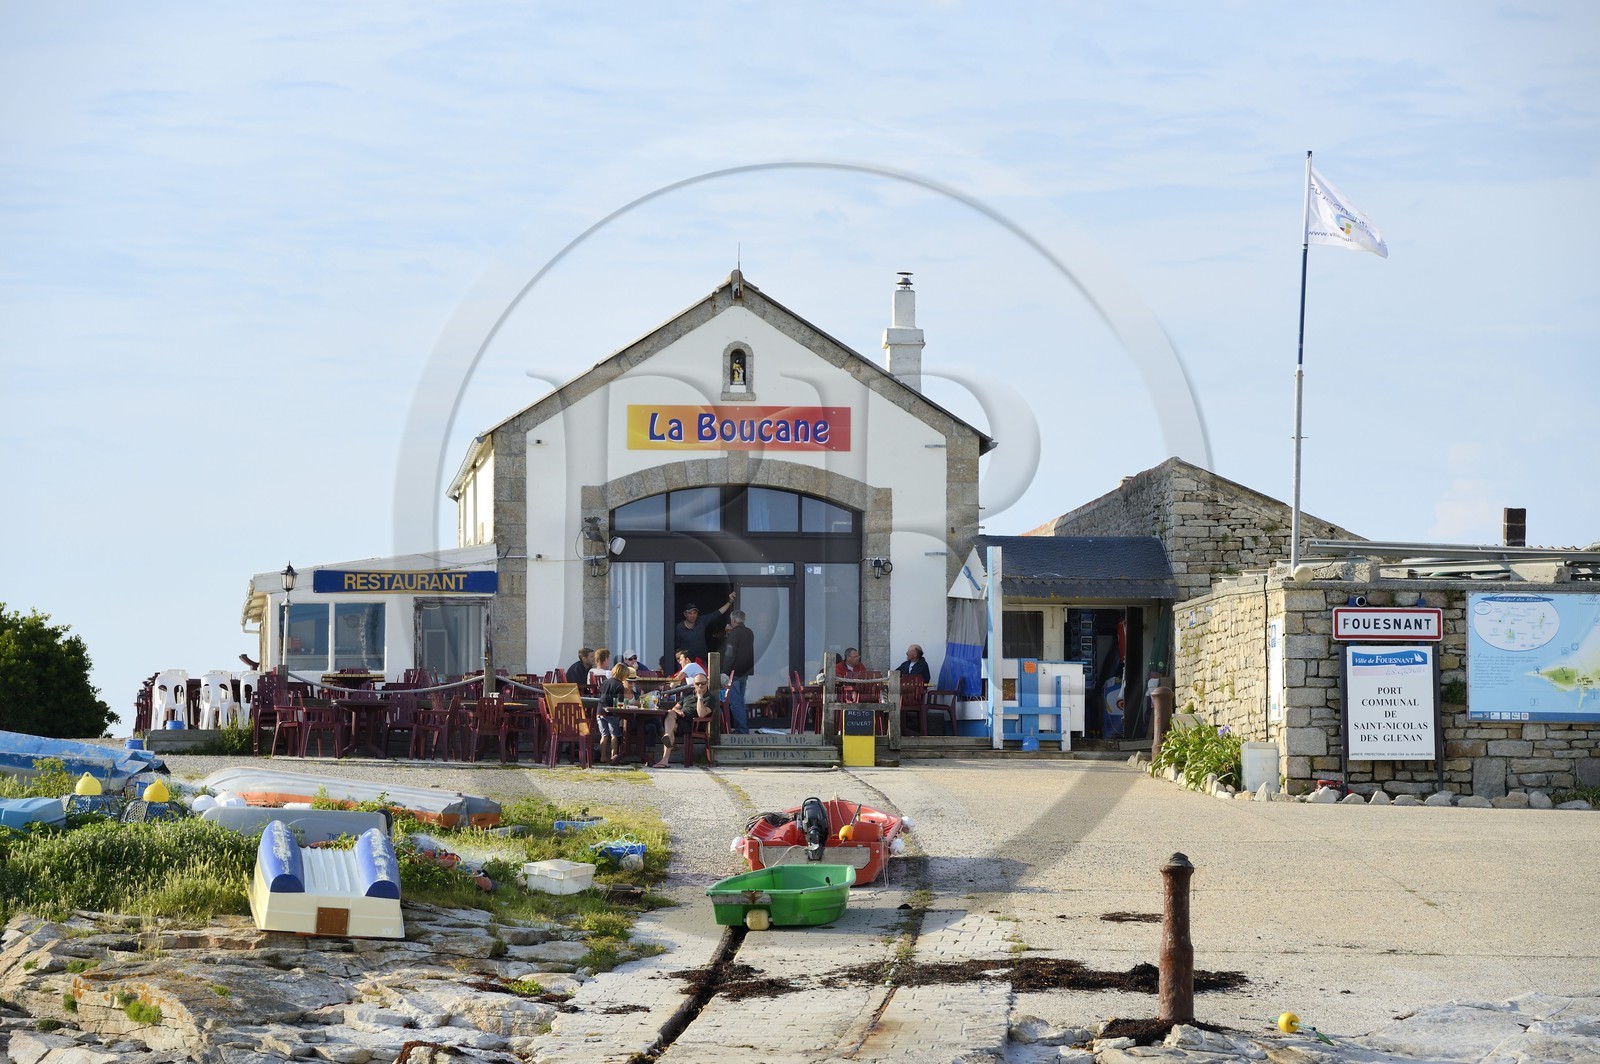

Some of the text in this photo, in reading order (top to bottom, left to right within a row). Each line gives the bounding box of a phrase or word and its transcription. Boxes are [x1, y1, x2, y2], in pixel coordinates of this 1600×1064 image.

[648, 412, 830, 444] La Boucane
[343, 573, 468, 590] RESTAURANT
[1343, 618, 1432, 630] FOUESNANT
[1375, 655, 1414, 664] FOUESNANT
[1377, 686, 1403, 695] PORT
[1361, 698, 1420, 707] COMMUNAL
[1384, 710, 1398, 718] DE
[1353, 722, 1429, 730] SAINT-NICOLAS
[1360, 734, 1424, 742] DES GLENAN
